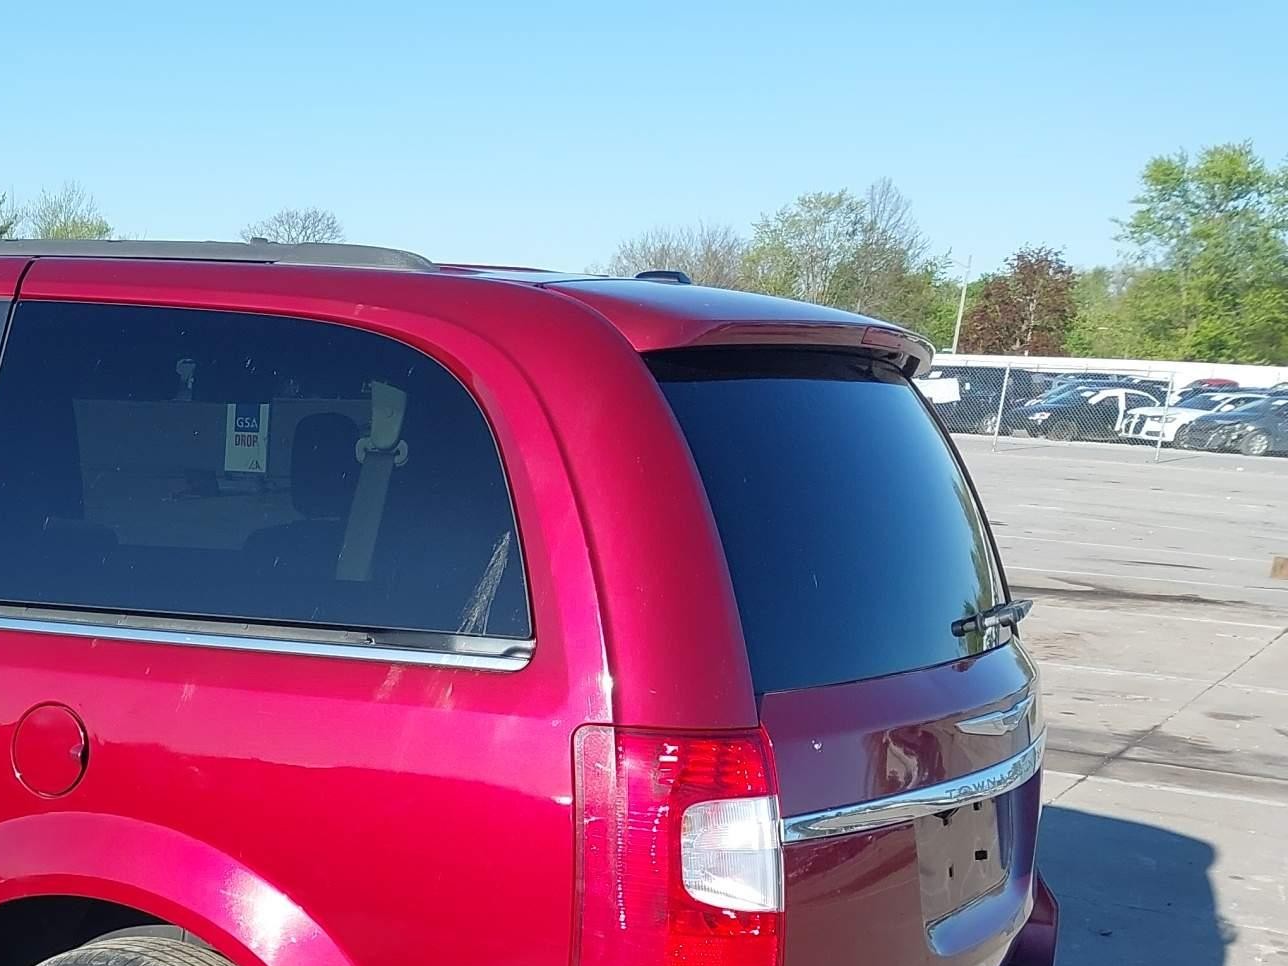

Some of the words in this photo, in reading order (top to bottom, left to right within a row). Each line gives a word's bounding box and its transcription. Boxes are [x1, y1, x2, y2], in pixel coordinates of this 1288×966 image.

[236, 417, 259, 429] GSA
[234, 433, 259, 448] DROP
[944, 776, 996, 800] TOWN
